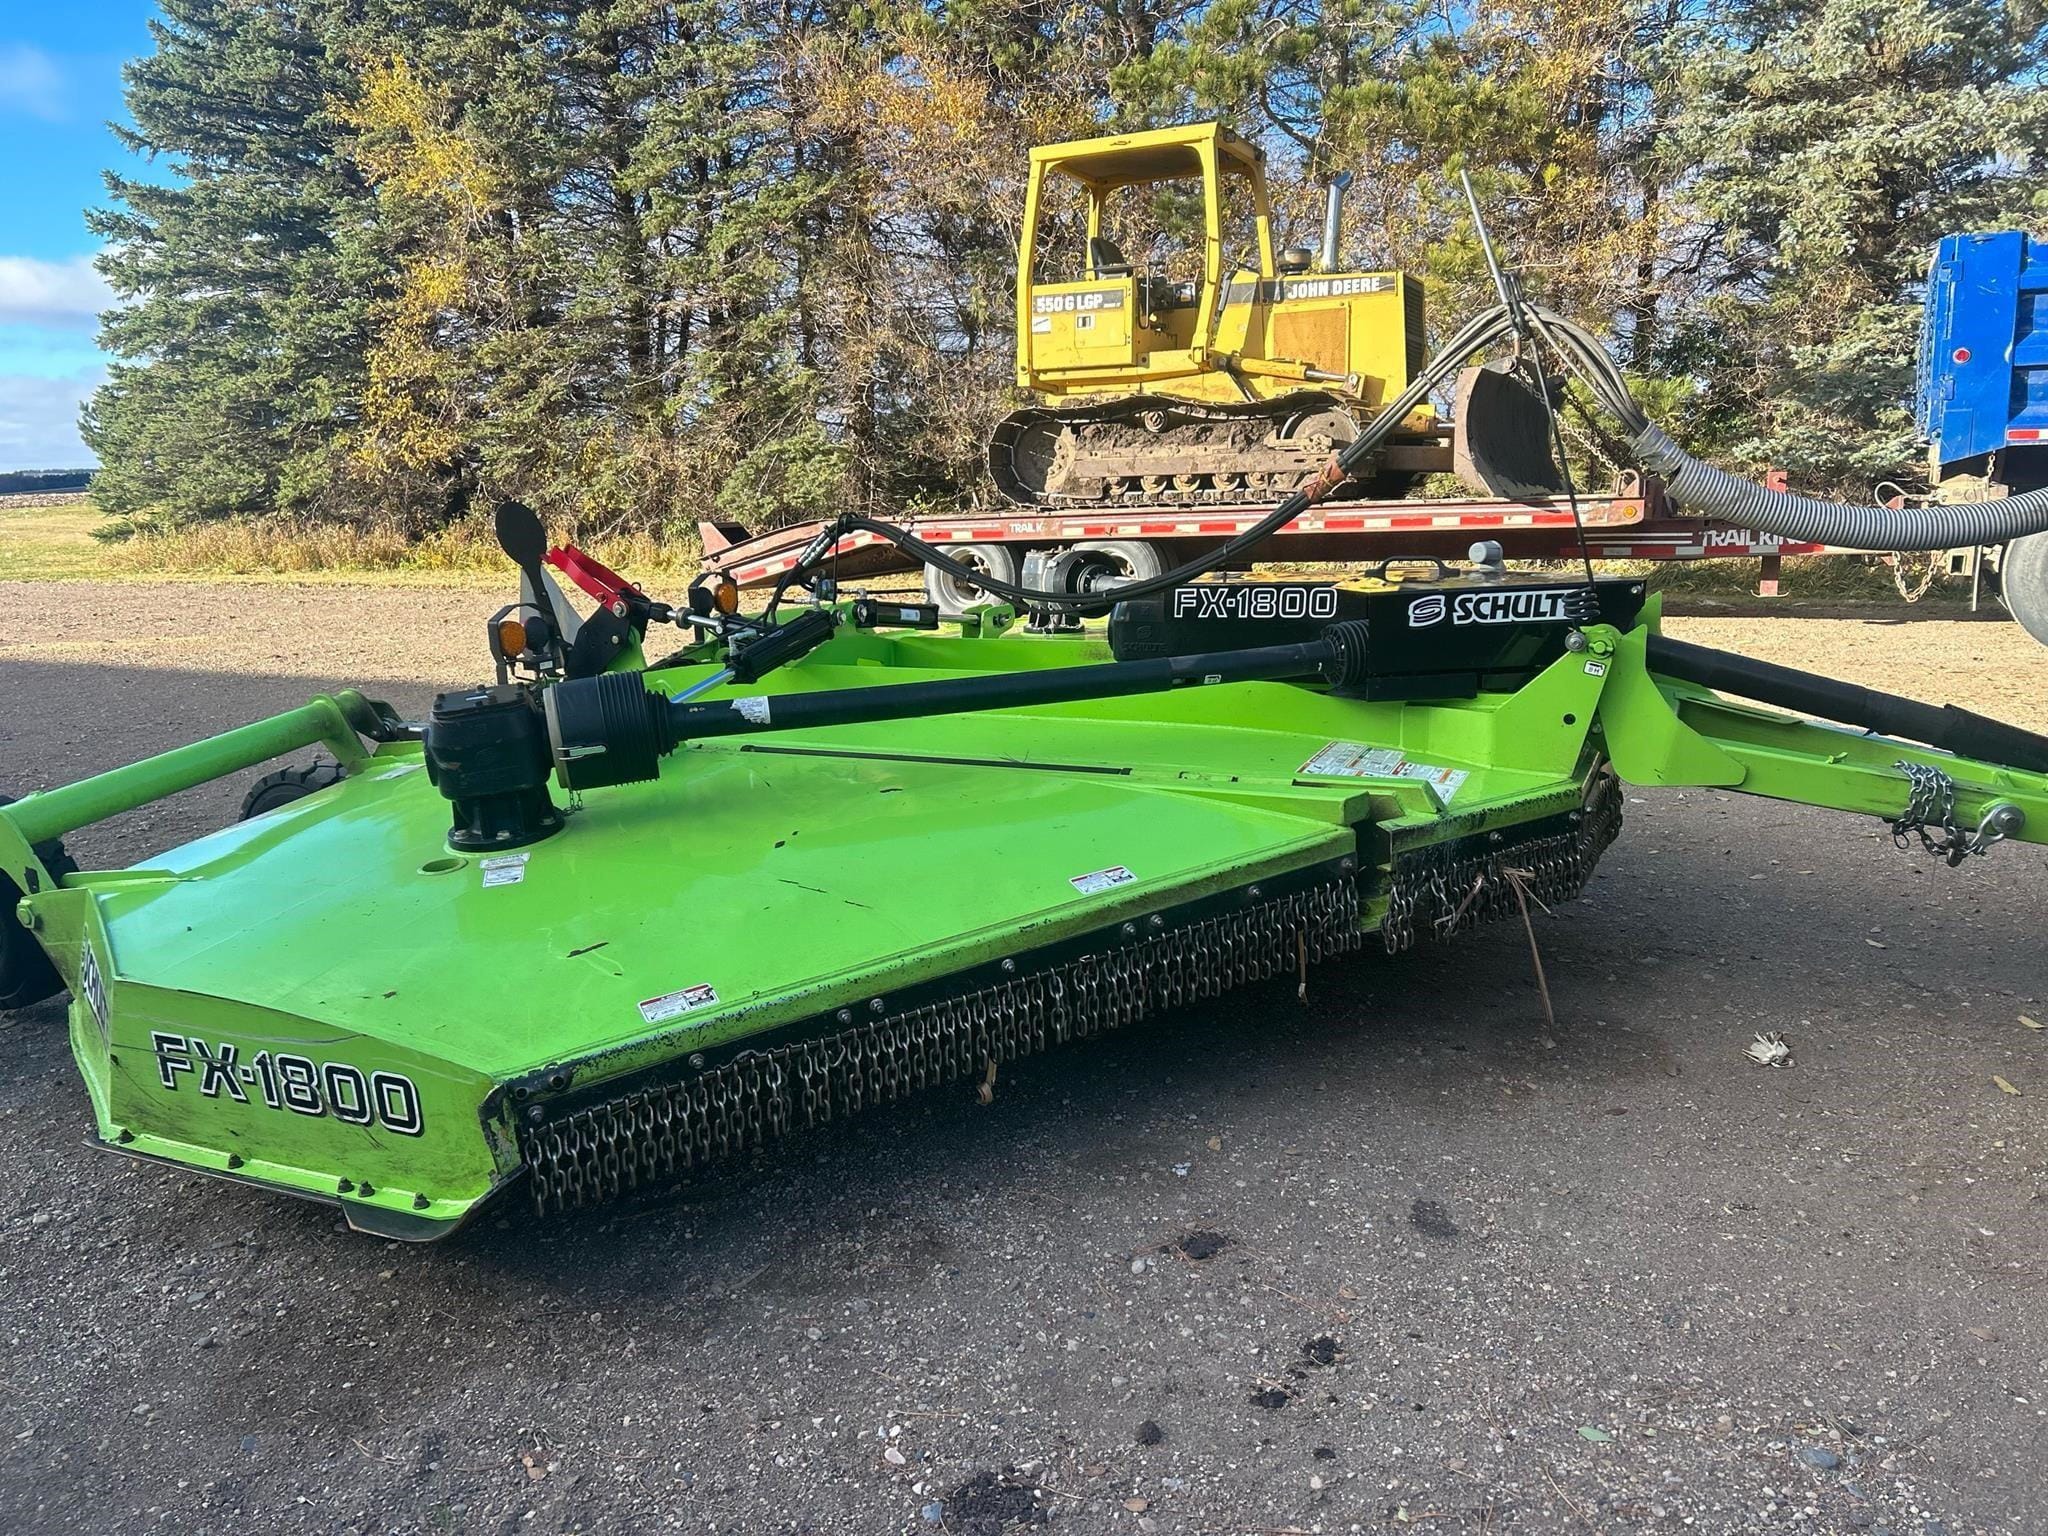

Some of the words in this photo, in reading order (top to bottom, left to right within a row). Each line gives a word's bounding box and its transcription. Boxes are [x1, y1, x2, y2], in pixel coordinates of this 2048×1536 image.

[1076, 293, 1103, 310] LGP
[1287, 280, 1329, 299] JOHN
[1332, 276, 1380, 296] DEERE
[1173, 587, 1338, 618] FX-1800
[1452, 589, 1587, 625] SCHULT
[150, 1030, 424, 1137] FX-1800
